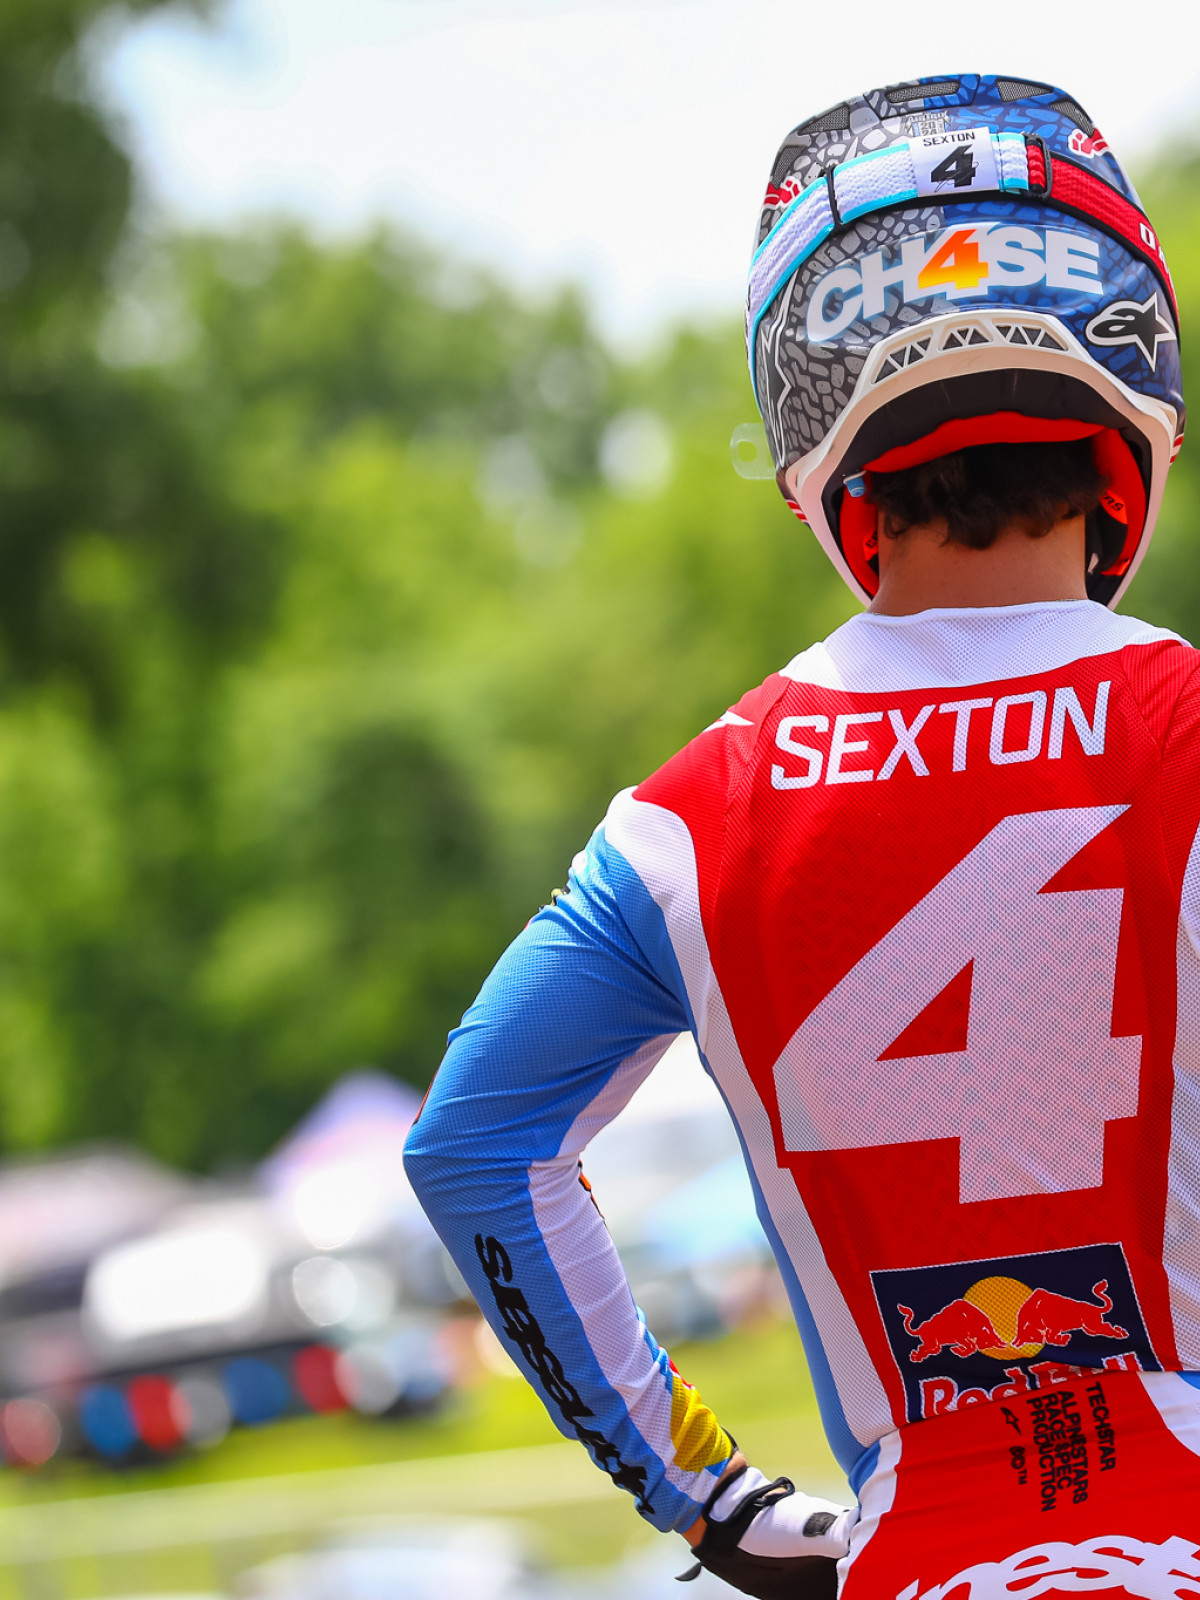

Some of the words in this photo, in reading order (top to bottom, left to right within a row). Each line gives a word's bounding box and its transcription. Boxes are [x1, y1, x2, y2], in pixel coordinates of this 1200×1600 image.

[923, 131, 976, 148] SEXTON
[931, 144, 976, 188] 4
[770, 680, 1112, 792] SEXTON
[772, 804, 1142, 1204] 4
[1026, 1396, 1057, 1512] PRODUCTION
[1041, 1393, 1067, 1442] RACE
[1086, 1381, 1116, 1472] TECHSTAR
